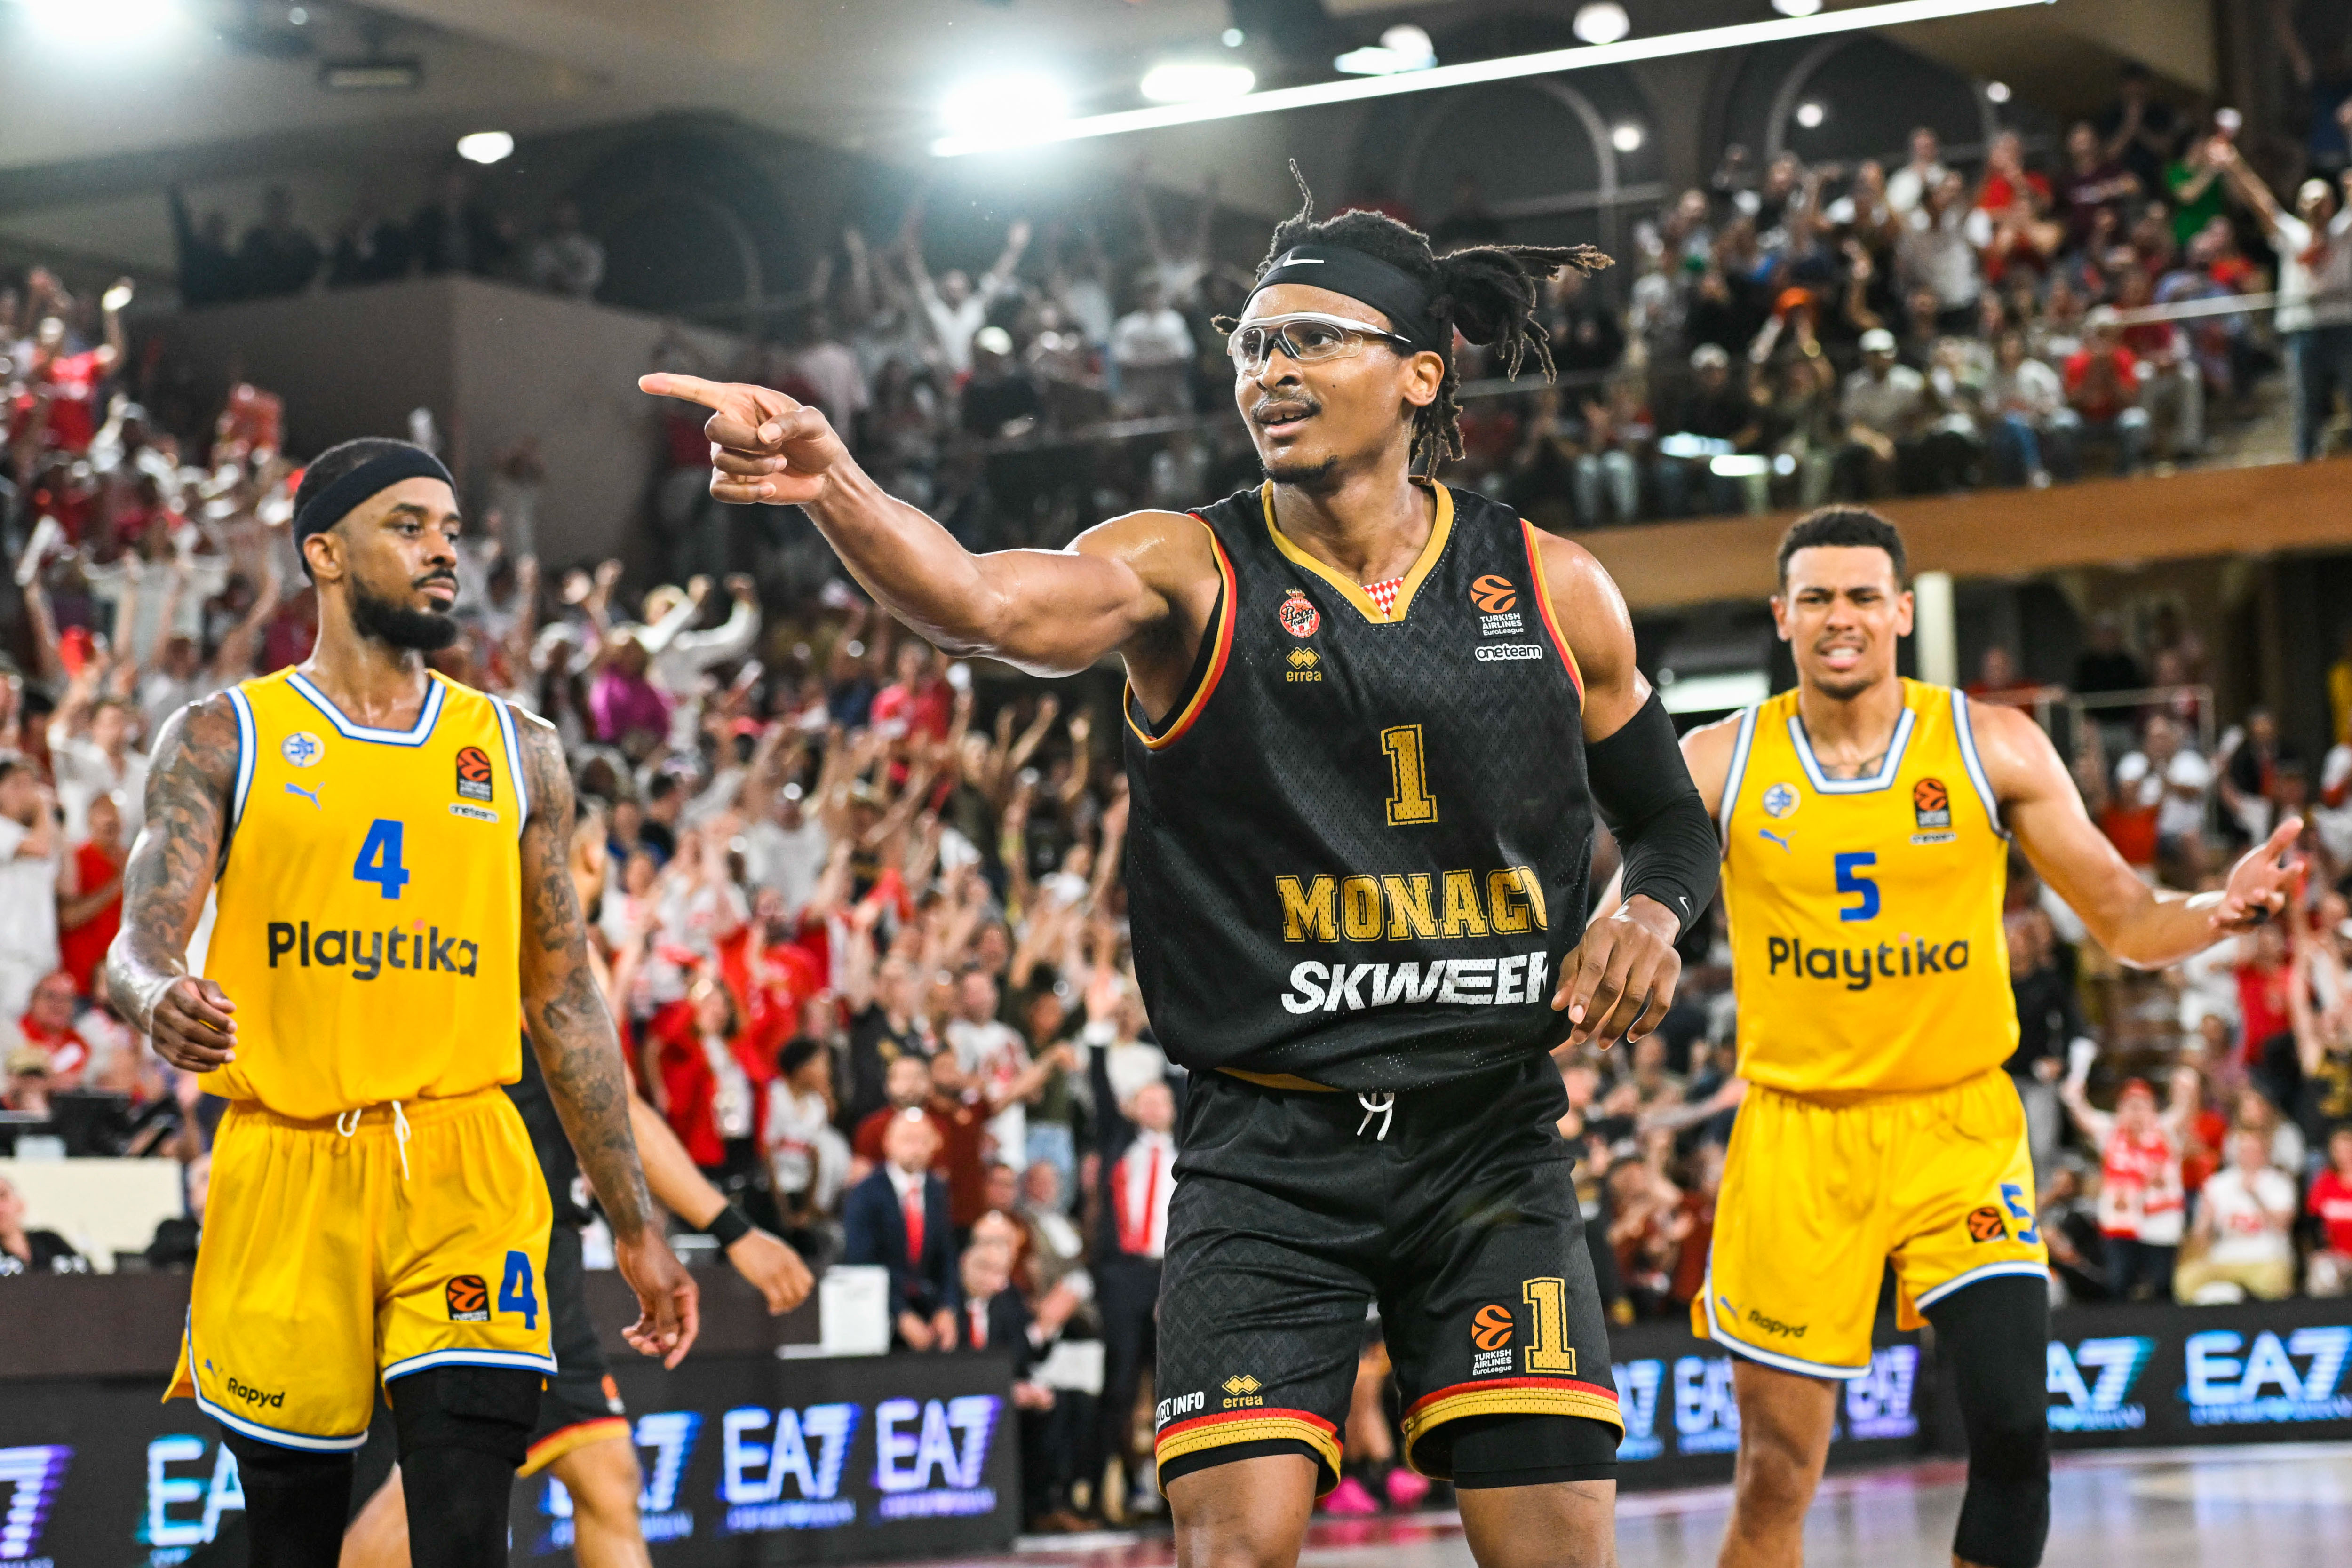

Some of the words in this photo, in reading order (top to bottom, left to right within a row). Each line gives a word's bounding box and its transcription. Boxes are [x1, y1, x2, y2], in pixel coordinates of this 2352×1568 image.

[1480, 613, 1521, 623] TURKISH
[1482, 620, 1522, 630] AIRLINES
[1477, 645, 1541, 659] oneteam
[1381, 724, 1438, 826] 1
[353, 819, 410, 900] 4
[1835, 852, 1881, 922] 5
[268, 919, 479, 981] Playtika
[1768, 932, 1969, 991] Playtika
[2000, 1184, 2039, 1244] 5
[498, 1250, 539, 1330] 4
[1474, 1349, 1512, 1361] TURKISH
[1523, 1277, 1577, 1376] 1
[227, 1377, 285, 1408] Rapyd
[1472, 1365, 1512, 1376] EuroLeague
[1473, 1356, 1512, 1369] AIRLINES
[2046, 1336, 2153, 1411] A7
[2184, 1326, 2352, 1406] EA7
[1173, 1391, 1204, 1416] INFO
[719, 1404, 860, 1505] EA7
[874, 1395, 1000, 1493] EA7
[147, 1435, 246, 1547] EA
